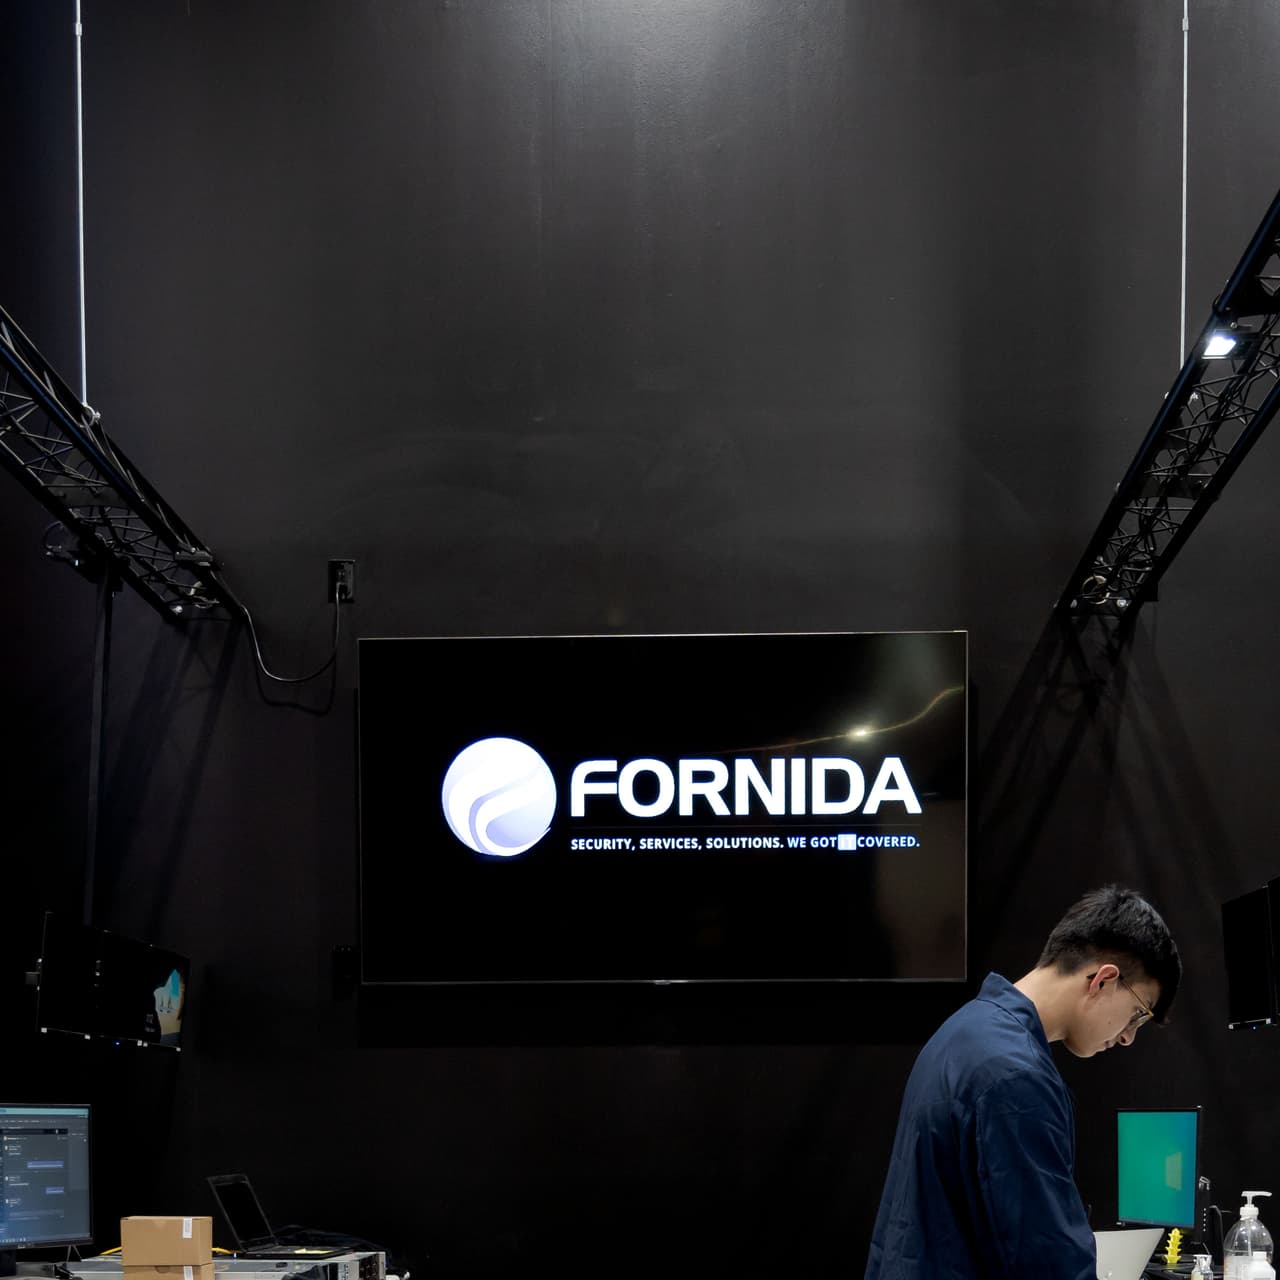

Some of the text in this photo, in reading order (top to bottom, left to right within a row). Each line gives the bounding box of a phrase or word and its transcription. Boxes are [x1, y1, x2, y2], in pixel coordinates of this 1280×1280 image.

[570, 757, 922, 817] FORNIDA
[570, 837, 635, 851] SECURITY,
[639, 837, 702, 850] SERVICES,
[705, 836, 784, 849] SOLUTIONS.
[786, 836, 807, 848] WE
[810, 836, 837, 848] GOT
[857, 835, 920, 848] COVERED.
